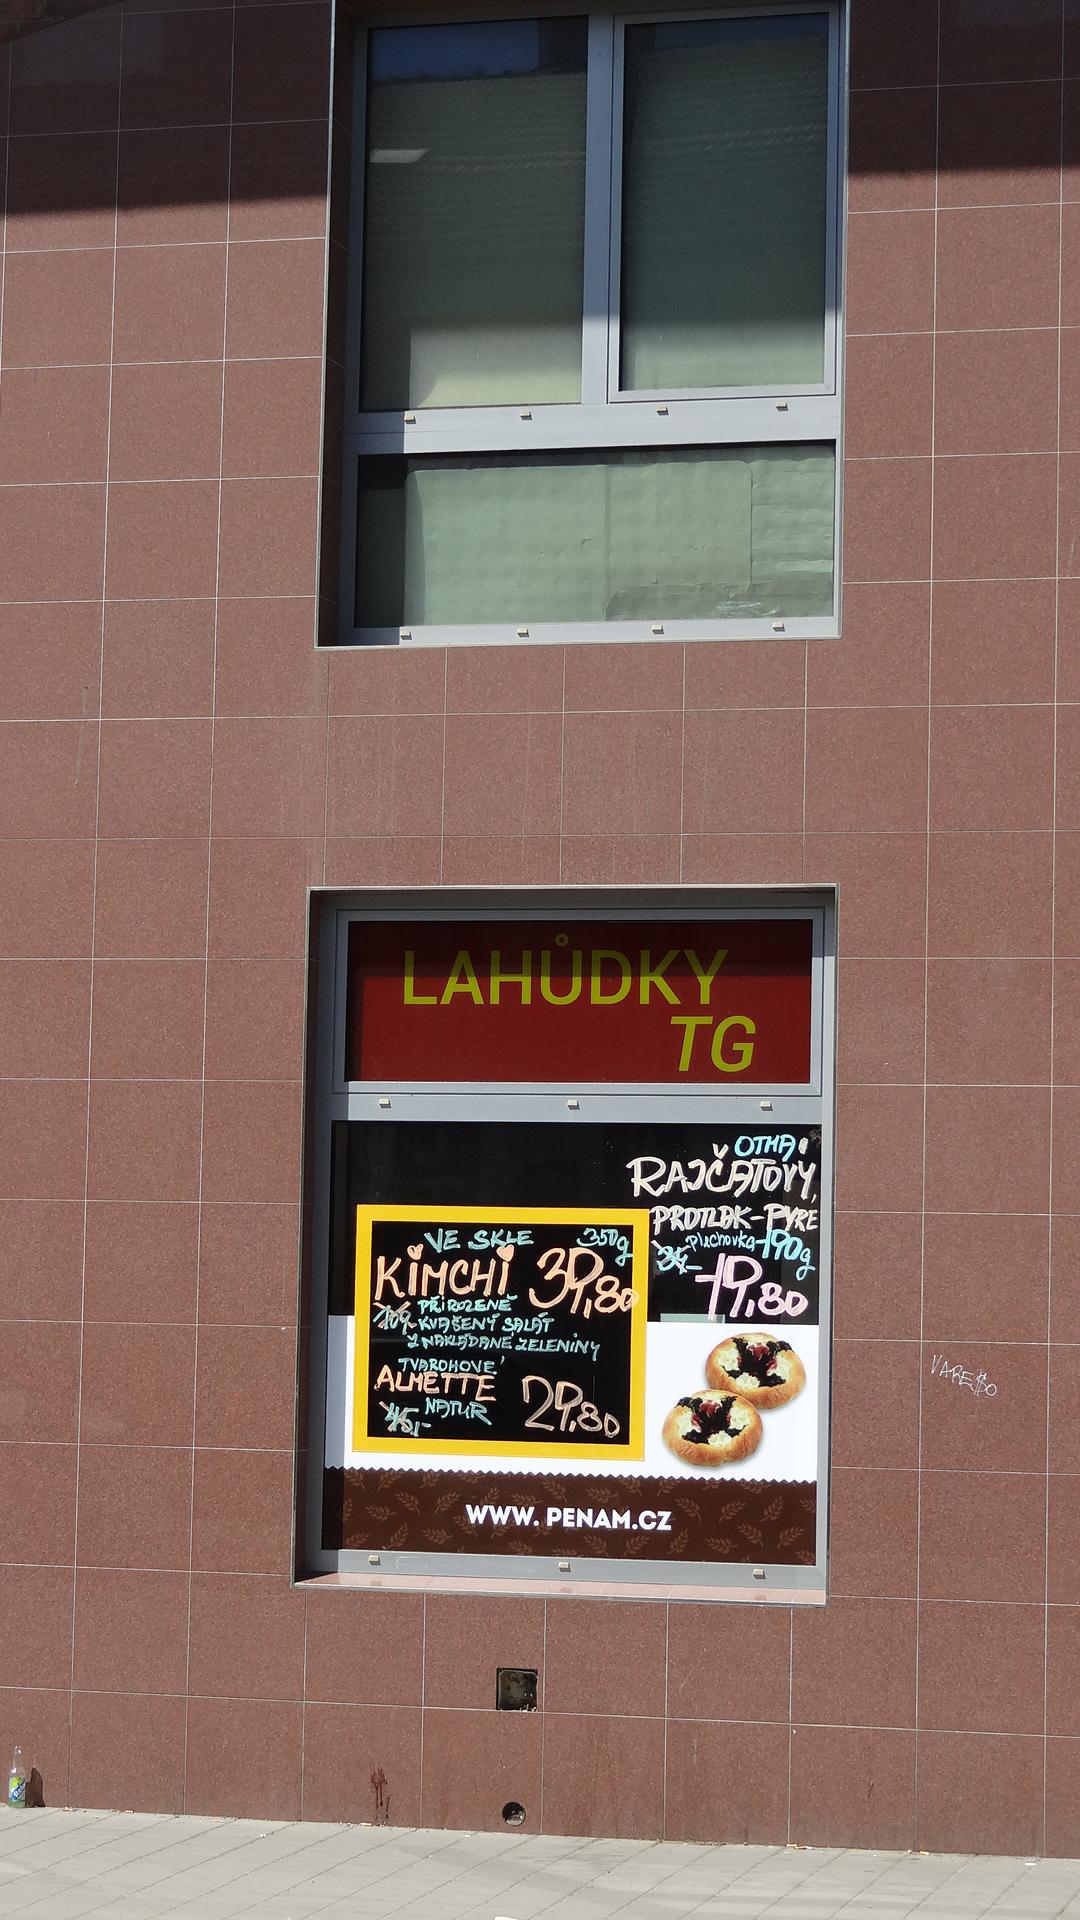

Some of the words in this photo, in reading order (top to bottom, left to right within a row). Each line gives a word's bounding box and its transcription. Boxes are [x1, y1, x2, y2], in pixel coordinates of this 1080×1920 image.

[403, 932, 729, 1006] LAHŮDKY
[670, 1015, 756, 1073] TG
[424, 1228, 459, 1254] VE
[468, 1229, 535, 1249] SKLE
[576, 1227, 633, 1267] 350g
[528, 1247, 640, 1318] 39,80
[373, 1364, 497, 1402] ALMETTE
[521, 1375, 620, 1438] 29,80
